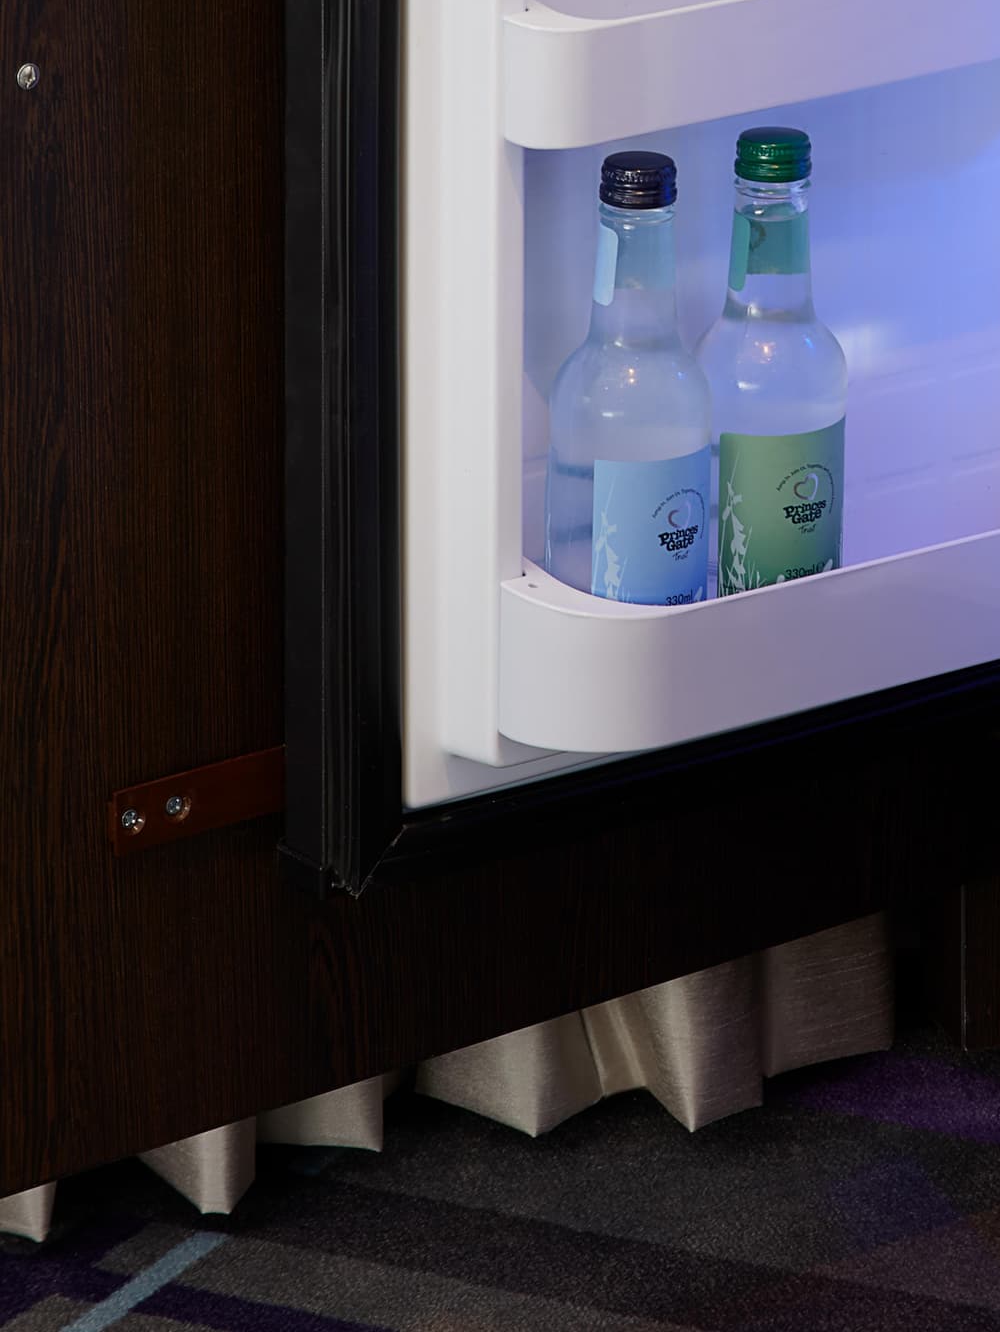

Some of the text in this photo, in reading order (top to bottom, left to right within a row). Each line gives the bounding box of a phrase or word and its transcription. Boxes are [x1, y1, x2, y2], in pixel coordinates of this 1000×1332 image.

[783, 500, 826, 519] Princes
[791, 510, 822, 524] Gate
[658, 525, 698, 546] Princes
[666, 535, 694, 551] Gate
[666, 588, 693, 606] 330ml
